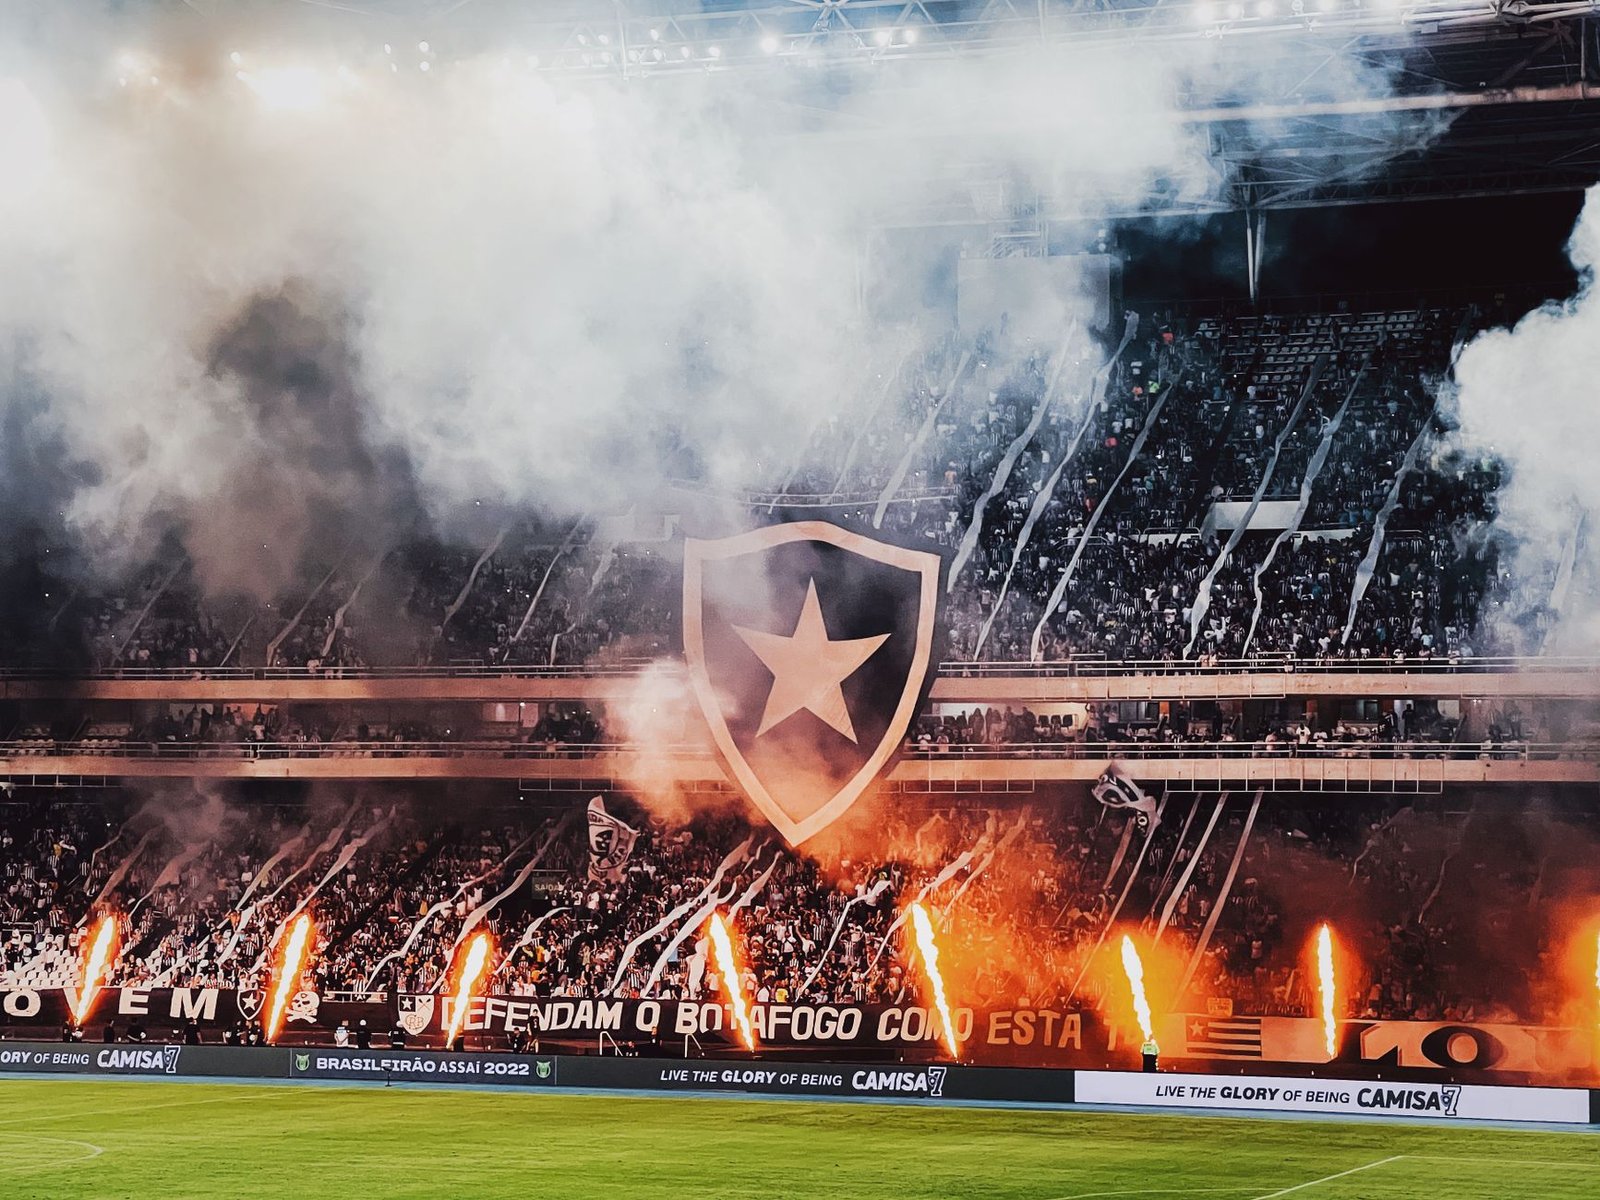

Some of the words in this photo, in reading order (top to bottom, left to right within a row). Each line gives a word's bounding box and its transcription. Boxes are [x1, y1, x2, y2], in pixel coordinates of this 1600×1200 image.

[635, 1000, 660, 1032] O
[987, 1010, 1082, 1050] ESTA
[33, 1053, 51, 1064] OF
[52, 1053, 90, 1065] BEING
[316, 1056, 436, 1074] BRASILEIRÃO
[438, 1060, 481, 1074] ASSAÍ
[484, 1062, 530, 1076] 2022
[660, 1069, 689, 1082] LIVE
[693, 1070, 719, 1083] THE
[721, 1070, 777, 1084] GLORY
[780, 1073, 798, 1085] OF
[800, 1073, 843, 1086] BEING
[1156, 1085, 1185, 1098] LIVE
[1189, 1086, 1217, 1099] THE
[1219, 1086, 1281, 1101] GLORY
[1282, 1089, 1303, 1102] OF
[1305, 1090, 1350, 1104] BEING
